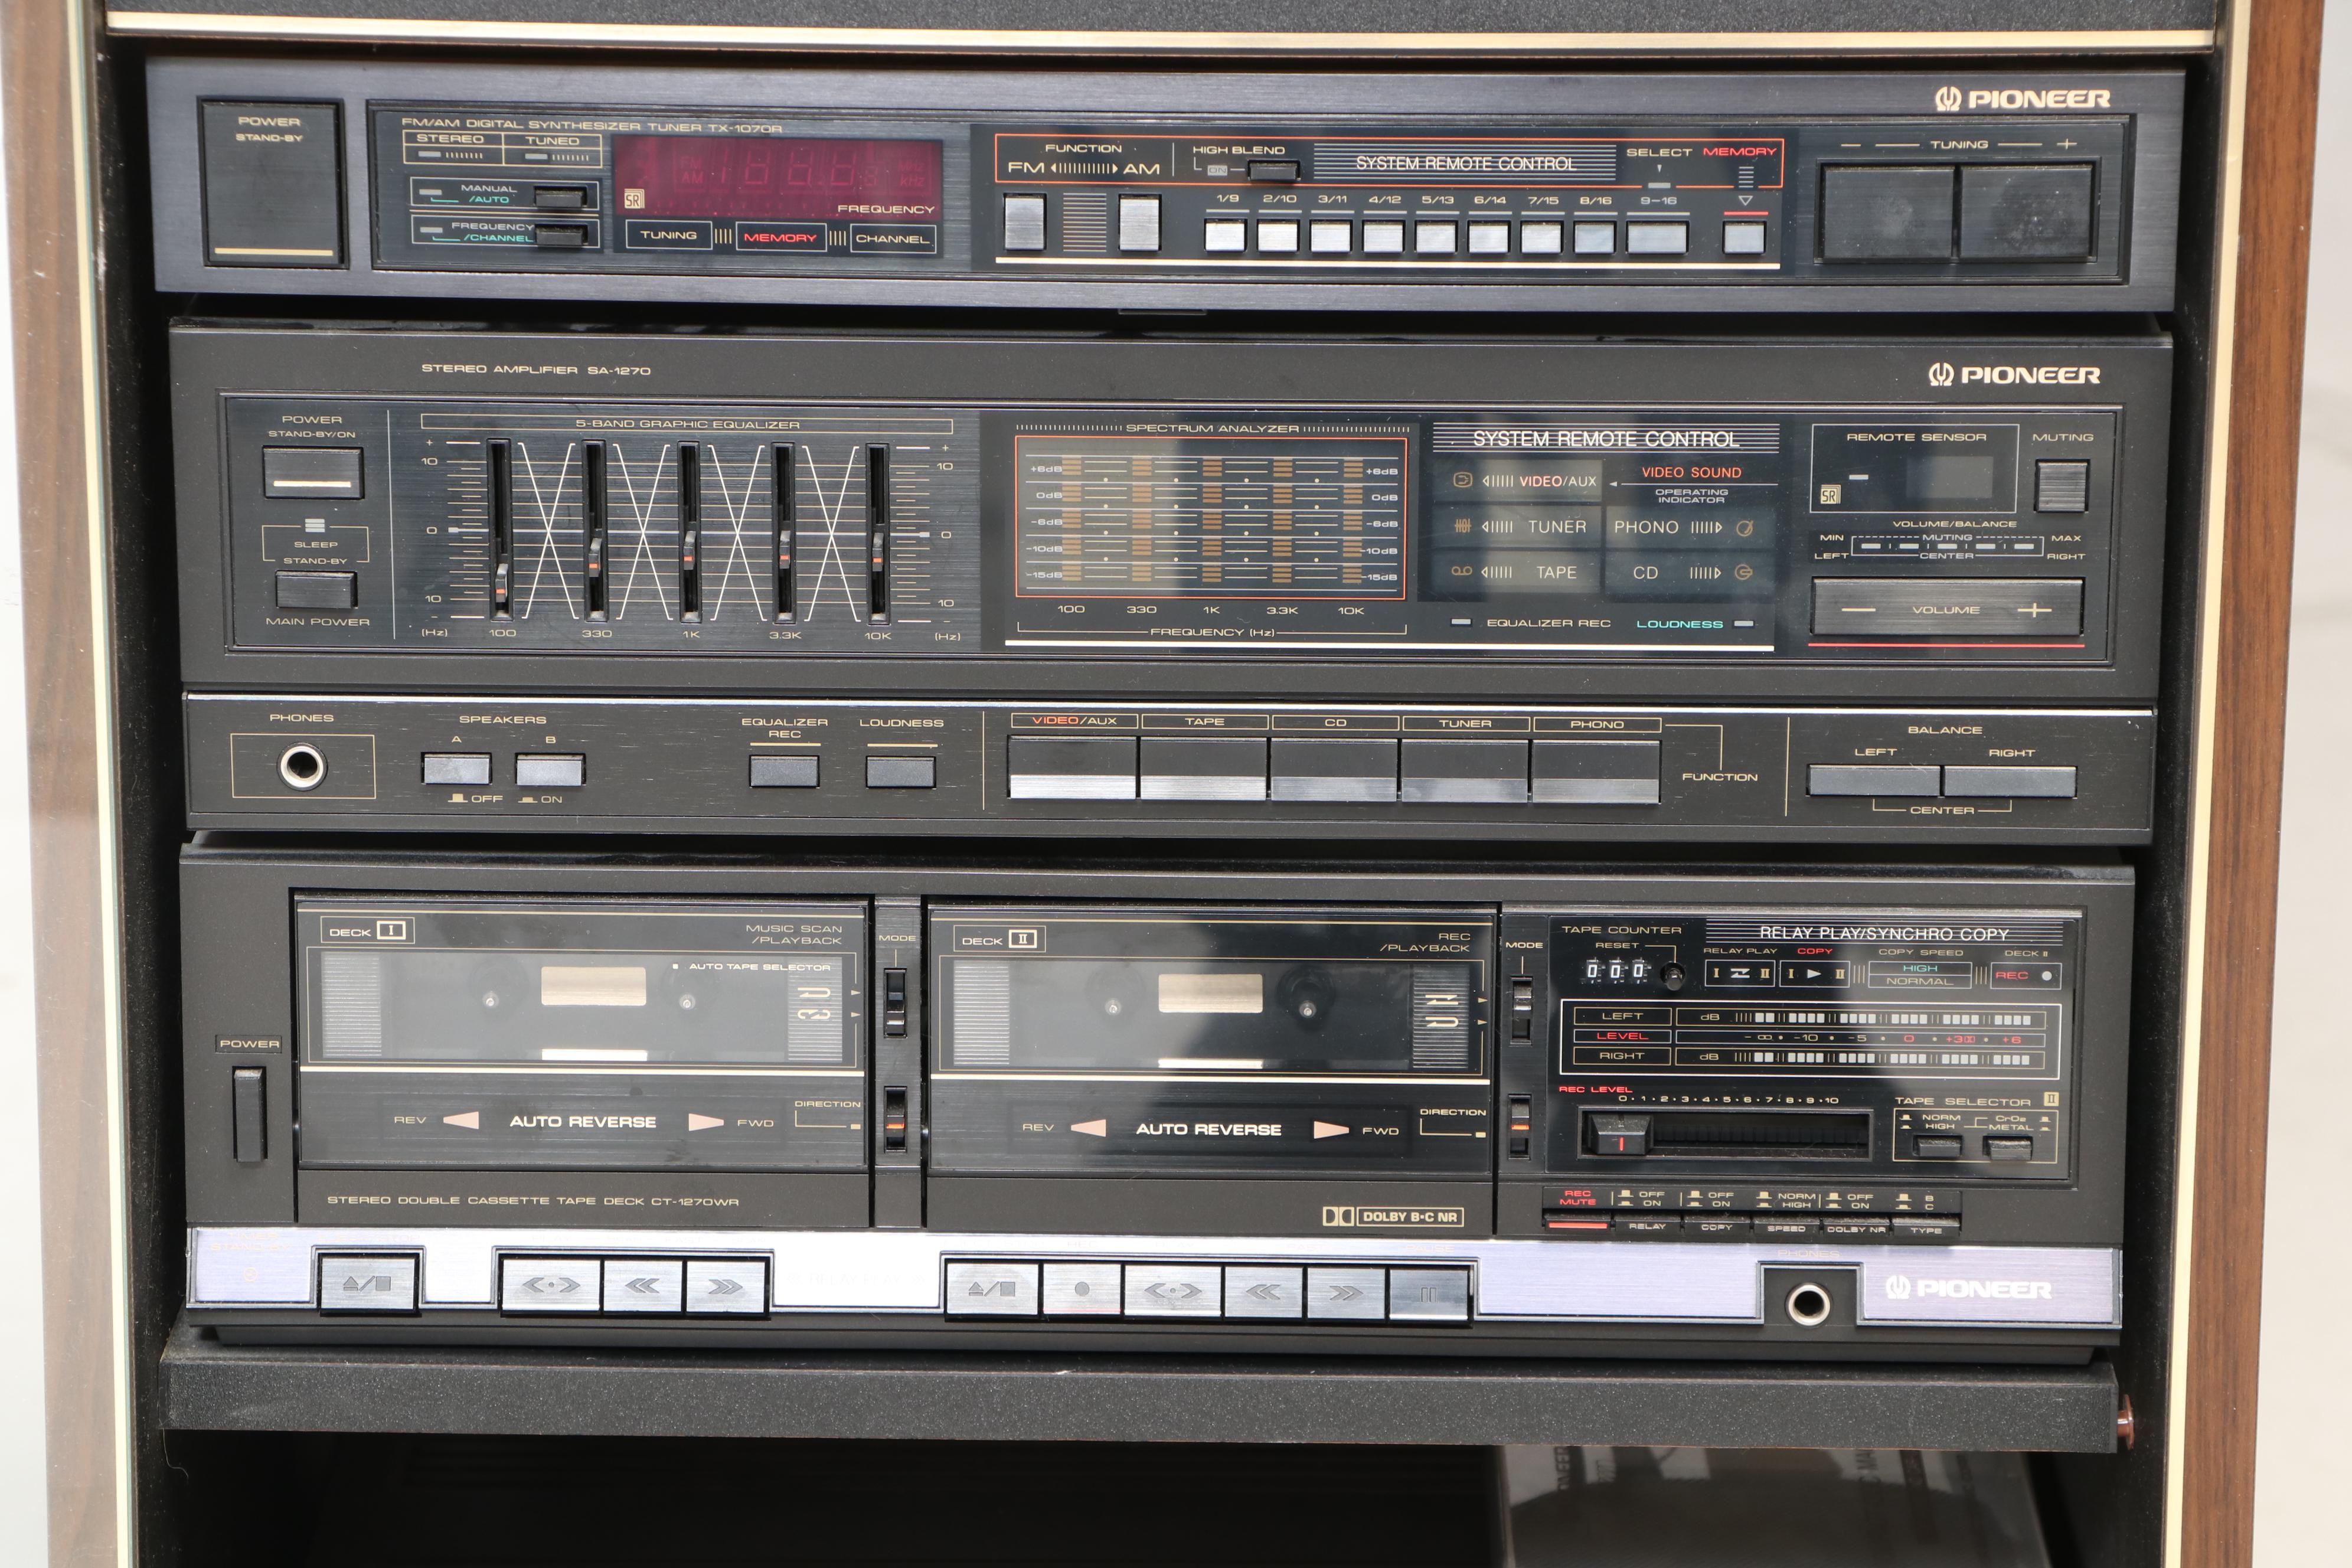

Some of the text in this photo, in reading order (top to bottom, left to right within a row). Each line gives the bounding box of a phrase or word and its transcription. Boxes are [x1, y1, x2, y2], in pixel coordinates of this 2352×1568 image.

[1969, 90, 2111, 109] PIONEER
[238, 116, 300, 126] POWER
[402, 117, 783, 133] FM/AM DIGITAL SYNTHESIZER TUNER TX-1070R
[236, 133, 303, 142] STAND-BY
[417, 133, 484, 143] STEREO
[525, 136, 580, 145] TUNED
[1045, 144, 1122, 153] FUNCTION
[1930, 140, 1989, 149] TUNING
[1193, 146, 1285, 155] HIGH BLEND
[1626, 148, 1693, 157] SELECT
[1703, 148, 1777, 156] MEMORY
[1008, 162, 1044, 173] FM
[1357, 156, 1577, 171] SYSTEM REMOTE CONTROL
[1123, 164, 1160, 175] AM
[461, 184, 517, 192] MANUAL
[1217, 194, 1239, 202] 1/9
[1263, 194, 1297, 203] 2/10
[1368, 195, 1402, 204] 4/12
[1580, 197, 1612, 205] 8/16
[1641, 197, 1677, 205] 9-16
[838, 205, 935, 214] FREQUENCY
[452, 222, 534, 231] FREQUENCY
[640, 231, 697, 240] TUNING
[744, 233, 816, 242] MEMORY
[856, 234, 930, 244] CHANNEL
[422, 364, 651, 375] STEREO AMPLIFIER SA-1270
[1962, 366, 2101, 384] PIONEER
[282, 416, 342, 424] POWER
[576, 419, 800, 429] 5-BAND GRAPHIC EQUALIZER
[1126, 424, 1213, 433] SPECTRUM
[1474, 431, 1740, 447] SYSTEM REMOTE CONTROL
[1847, 433, 1987, 442] REMOTE SENSOR
[2033, 433, 2094, 442] MUTING
[1642, 467, 1742, 478] VIDEO SOUND
[1520, 475, 1596, 487] VIDEO/AUX
[1528, 520, 1586, 534] TUNER
[1615, 520, 1679, 534] PHONO
[1537, 566, 1577, 579] TAPE
[1634, 566, 1658, 579] CD
[311, 618, 370, 626] POWER
[1578, 619, 1611, 628] REC
[1637, 620, 1723, 629] LOUDNESS
[769, 631, 802, 639] 3.3K
[1151, 628, 1275, 638] FREQUENCY (Hz)
[270, 714, 334, 722] PHONES
[459, 716, 547, 724] SPEAKERS
[741, 718, 828, 726] EQUALIZER
[860, 718, 944, 727] LOUDNESS
[1032, 716, 1117, 725] VIDEO/AUX
[1439, 720, 1492, 728] TUNER
[1570, 720, 1624, 729] PHONO
[1908, 726, 1983, 734] BALANCE
[1855, 748, 1897, 756] LEFT
[1683, 773, 1758, 782] FUNCTION
[541, 795, 563, 803] ON
[1910, 806, 1975, 815] CENTER
[329, 929, 371, 937] DECK
[746, 925, 794, 933] MUSIC
[1562, 926, 1602, 934] TAPE
[1761, 926, 2009, 941] RELAY PLAY/SYNCHRO COPY
[752, 936, 842, 945] /PLAYBACK
[1380, 944, 1470, 952] /PLAYBACK
[1886, 977, 1954, 985] NORMAL
[1895, 1097, 2031, 1106] TAPE SELECTOR
[509, 1115, 656, 1128] AUTO REVERSE
[1136, 1123, 1282, 1136] AUTO REVERSE
[328, 1196, 391, 1204] STEREO
[468, 1197, 550, 1205] CASSETTE
[604, 1197, 644, 1206] DECK
[651, 1198, 739, 1206] CT-1270WR
[1363, 1211, 1457, 1222] DOLBY NR
[1778, 1249, 1840, 1257] PHONES
[1917, 1279, 2052, 1299] PIONEER
